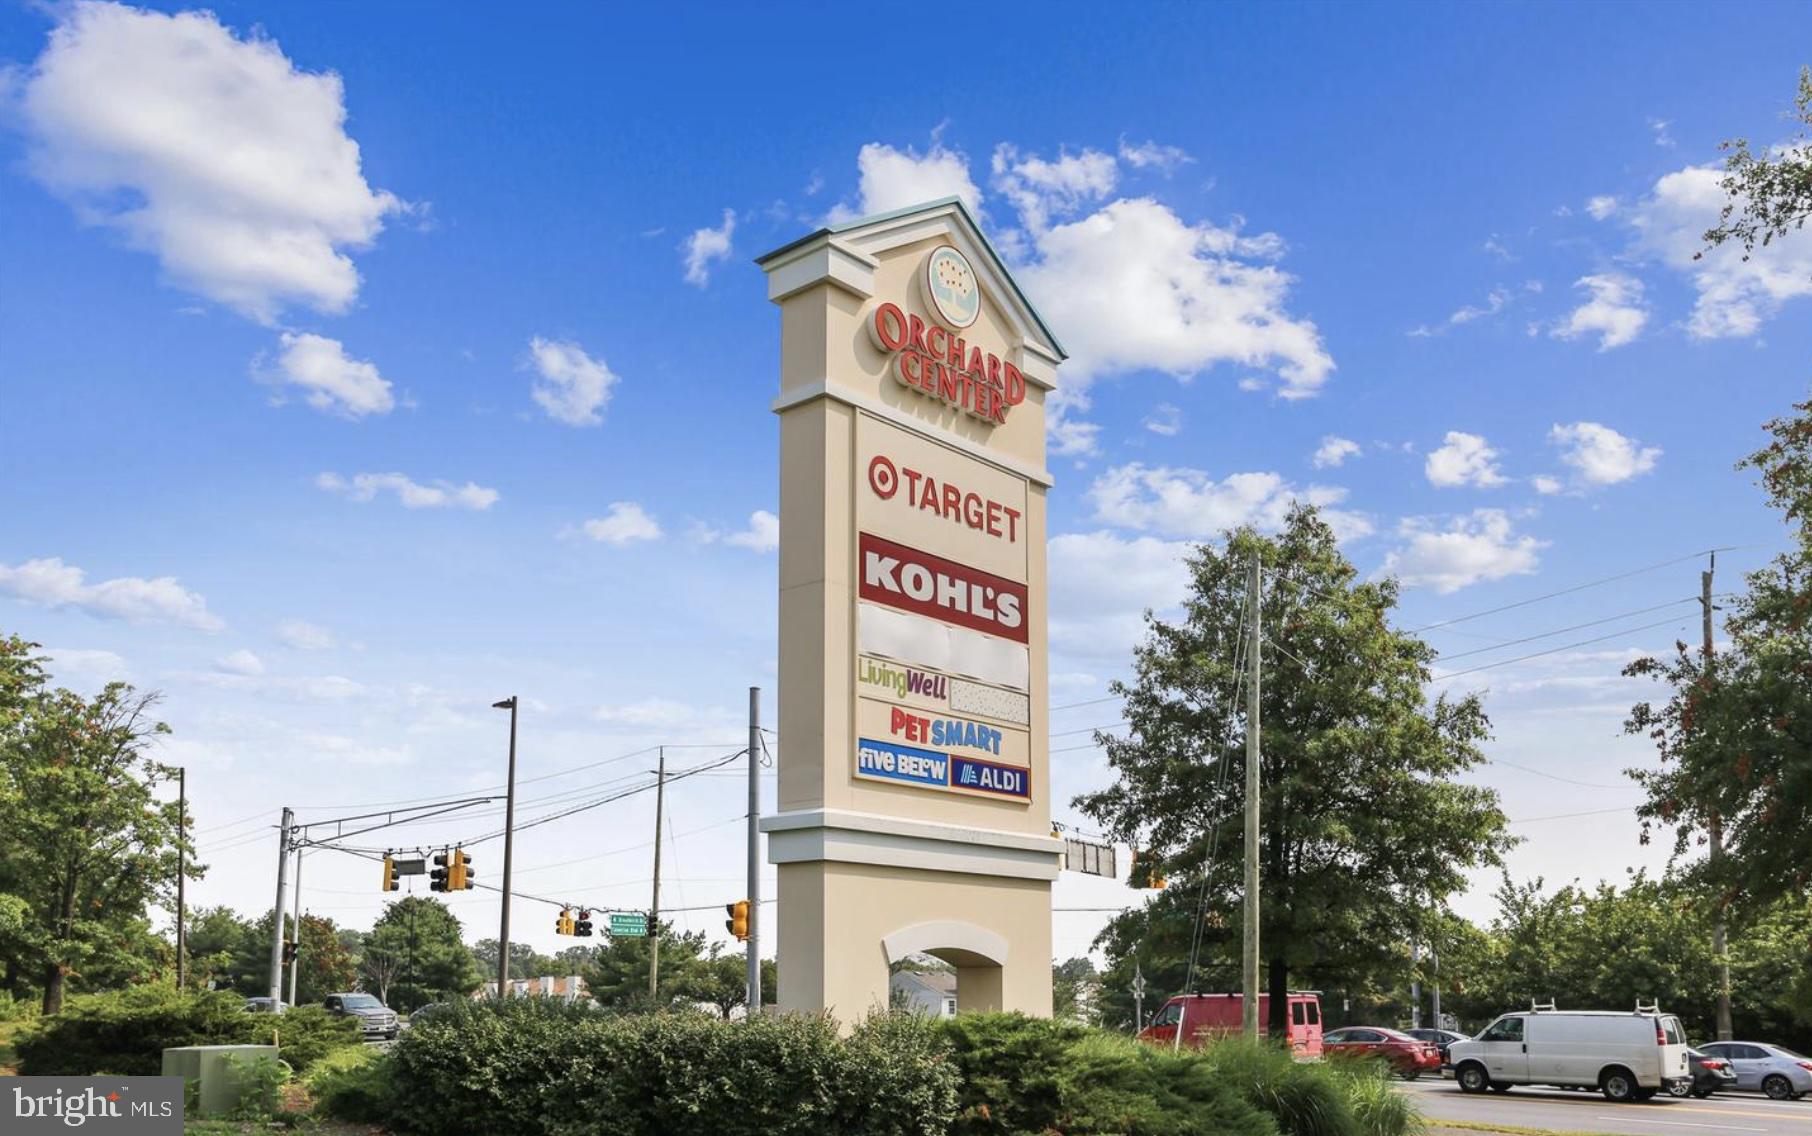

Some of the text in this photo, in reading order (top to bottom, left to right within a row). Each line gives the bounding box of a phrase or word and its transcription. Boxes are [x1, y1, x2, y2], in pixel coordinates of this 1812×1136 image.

[875, 302, 1026, 406] ORCHARD
[900, 350, 1006, 424] CENTER
[902, 467, 1021, 542] TARGET
[865, 551, 1022, 628] KOHL'S
[979, 767, 1021, 792] ALDI
